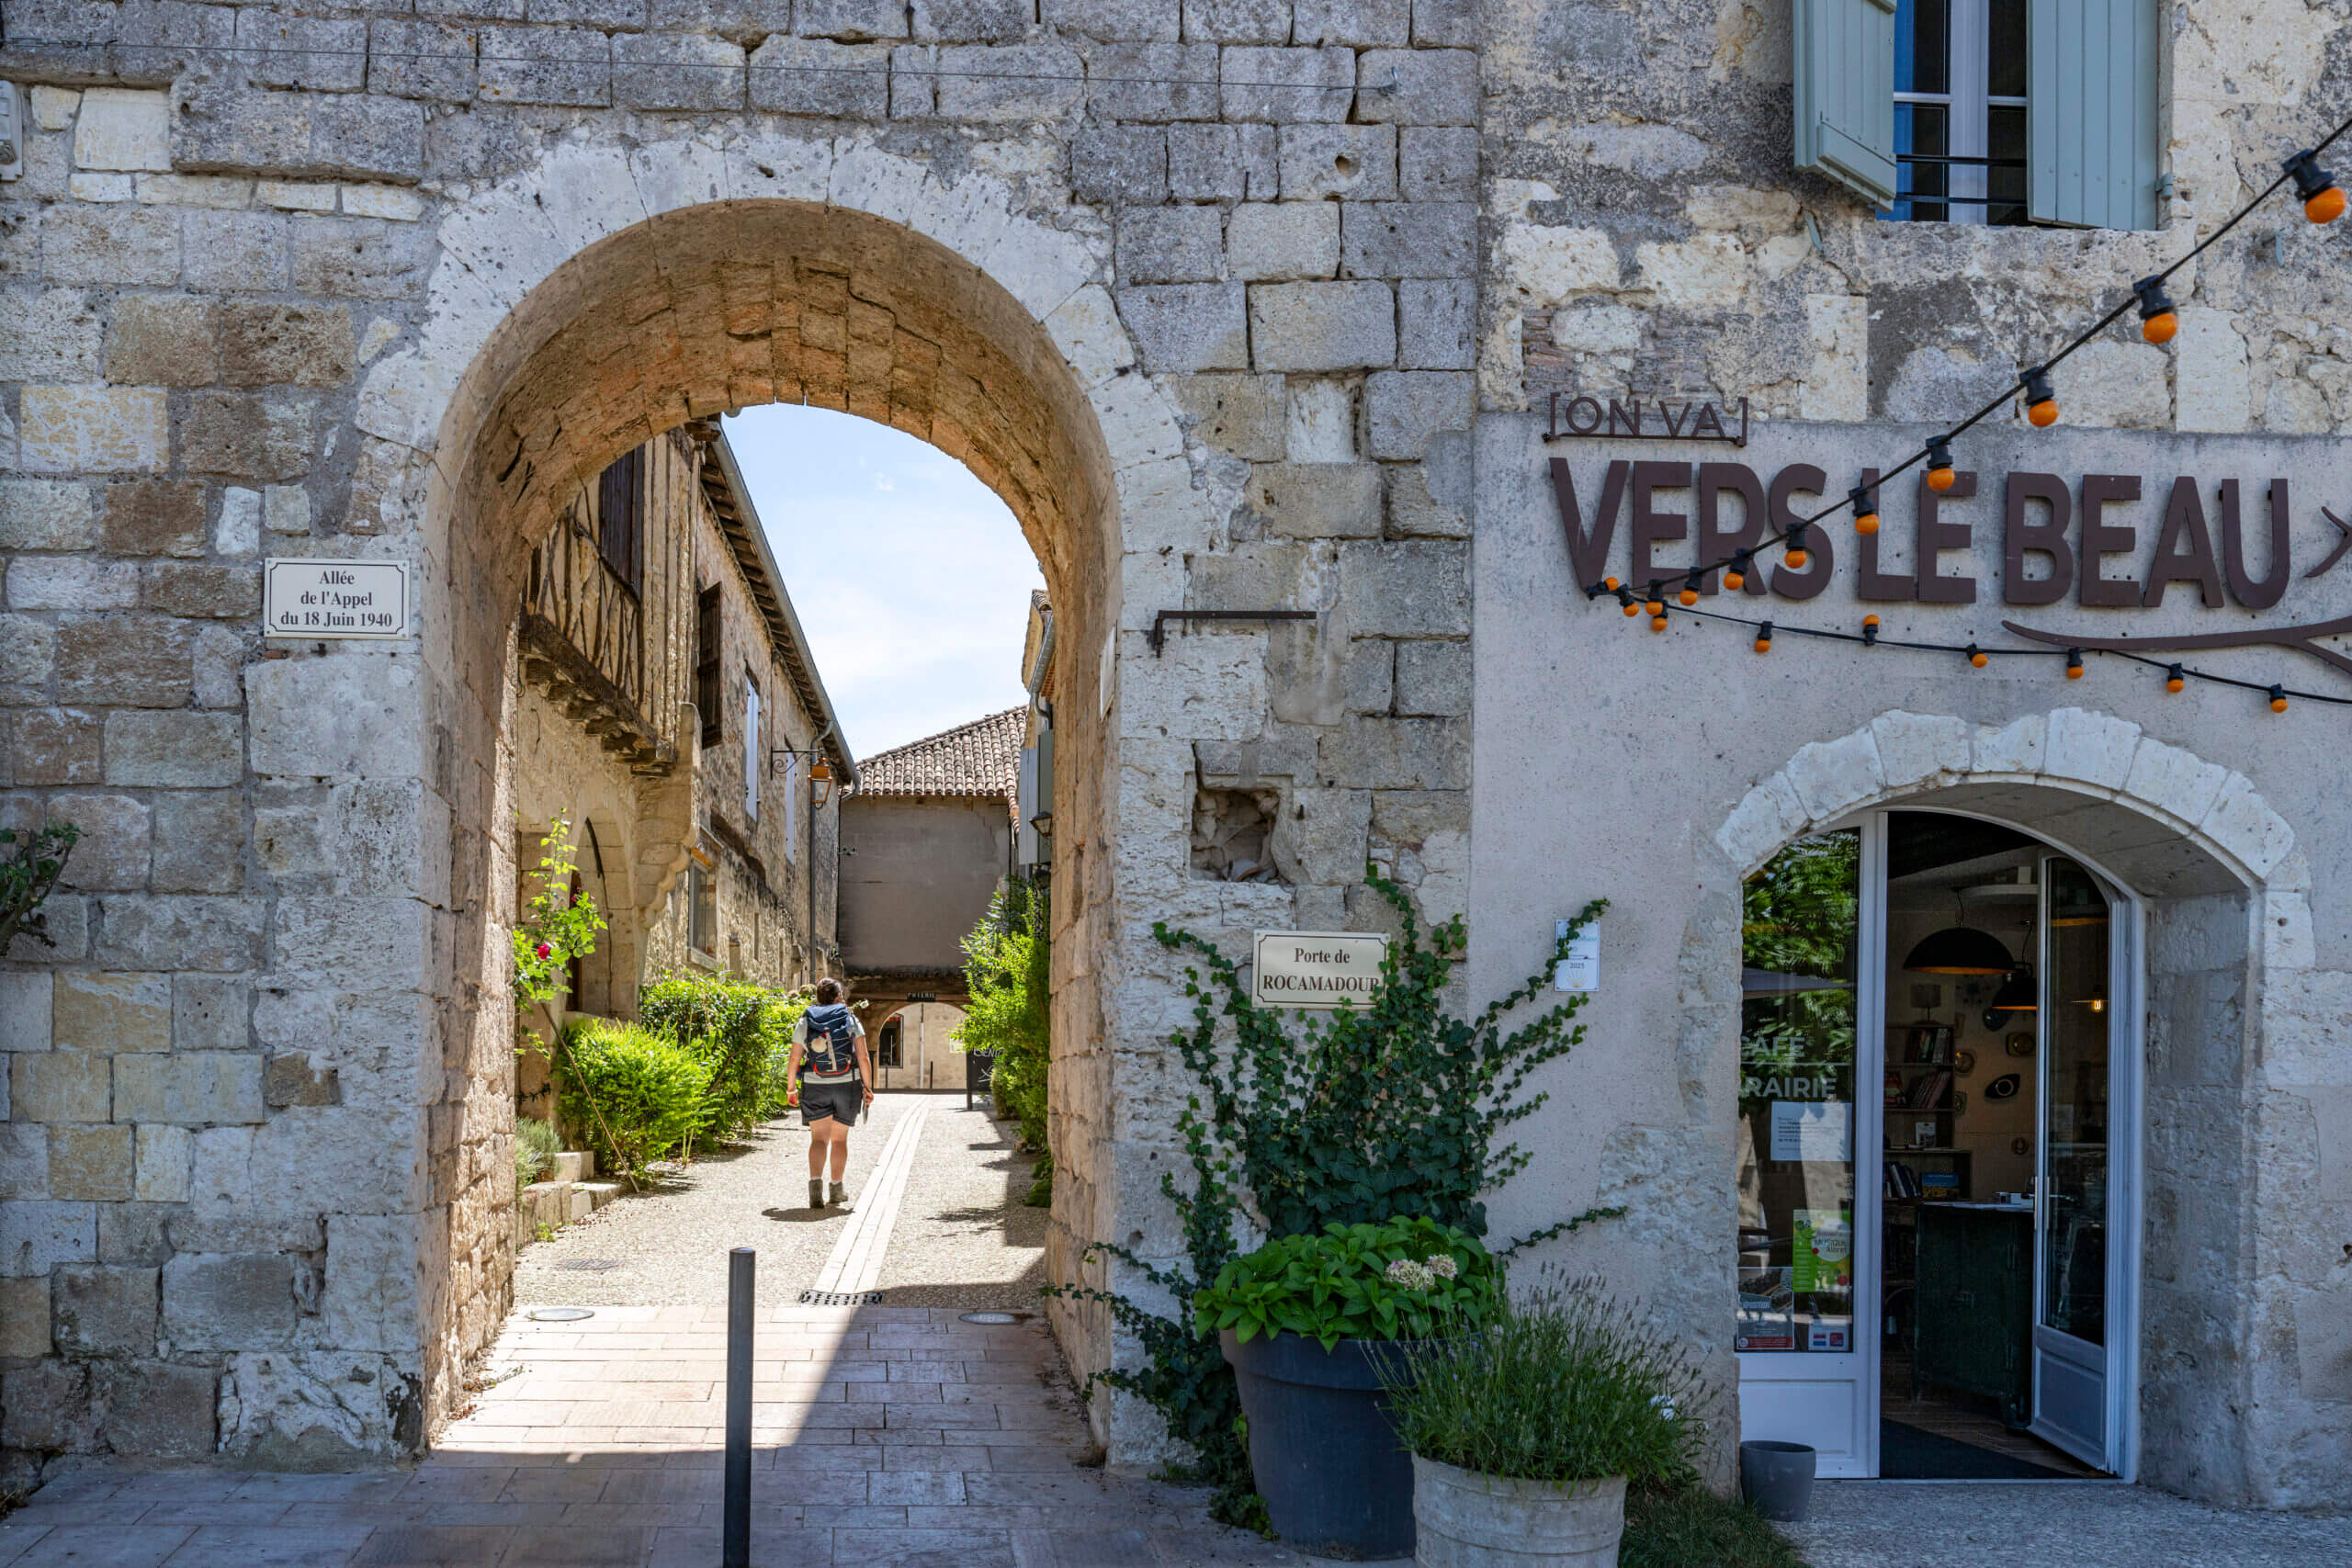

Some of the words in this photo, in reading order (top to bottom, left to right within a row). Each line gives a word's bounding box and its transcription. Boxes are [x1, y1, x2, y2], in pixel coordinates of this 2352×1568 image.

[1549, 457, 1834, 599] VERS
[1859, 467, 1977, 604] LE
[2006, 471, 2290, 609] BEAU
[319, 570, 355, 585] Allée
[300, 591, 317, 604] de
[322, 591, 373, 609] l'Appel
[280, 611, 299, 626] du
[304, 612, 320, 626] 18
[323, 612, 355, 626] Juin
[360, 613, 392, 626] 1940
[1295, 947, 1331, 964] Porte
[1335, 949, 1351, 964] de
